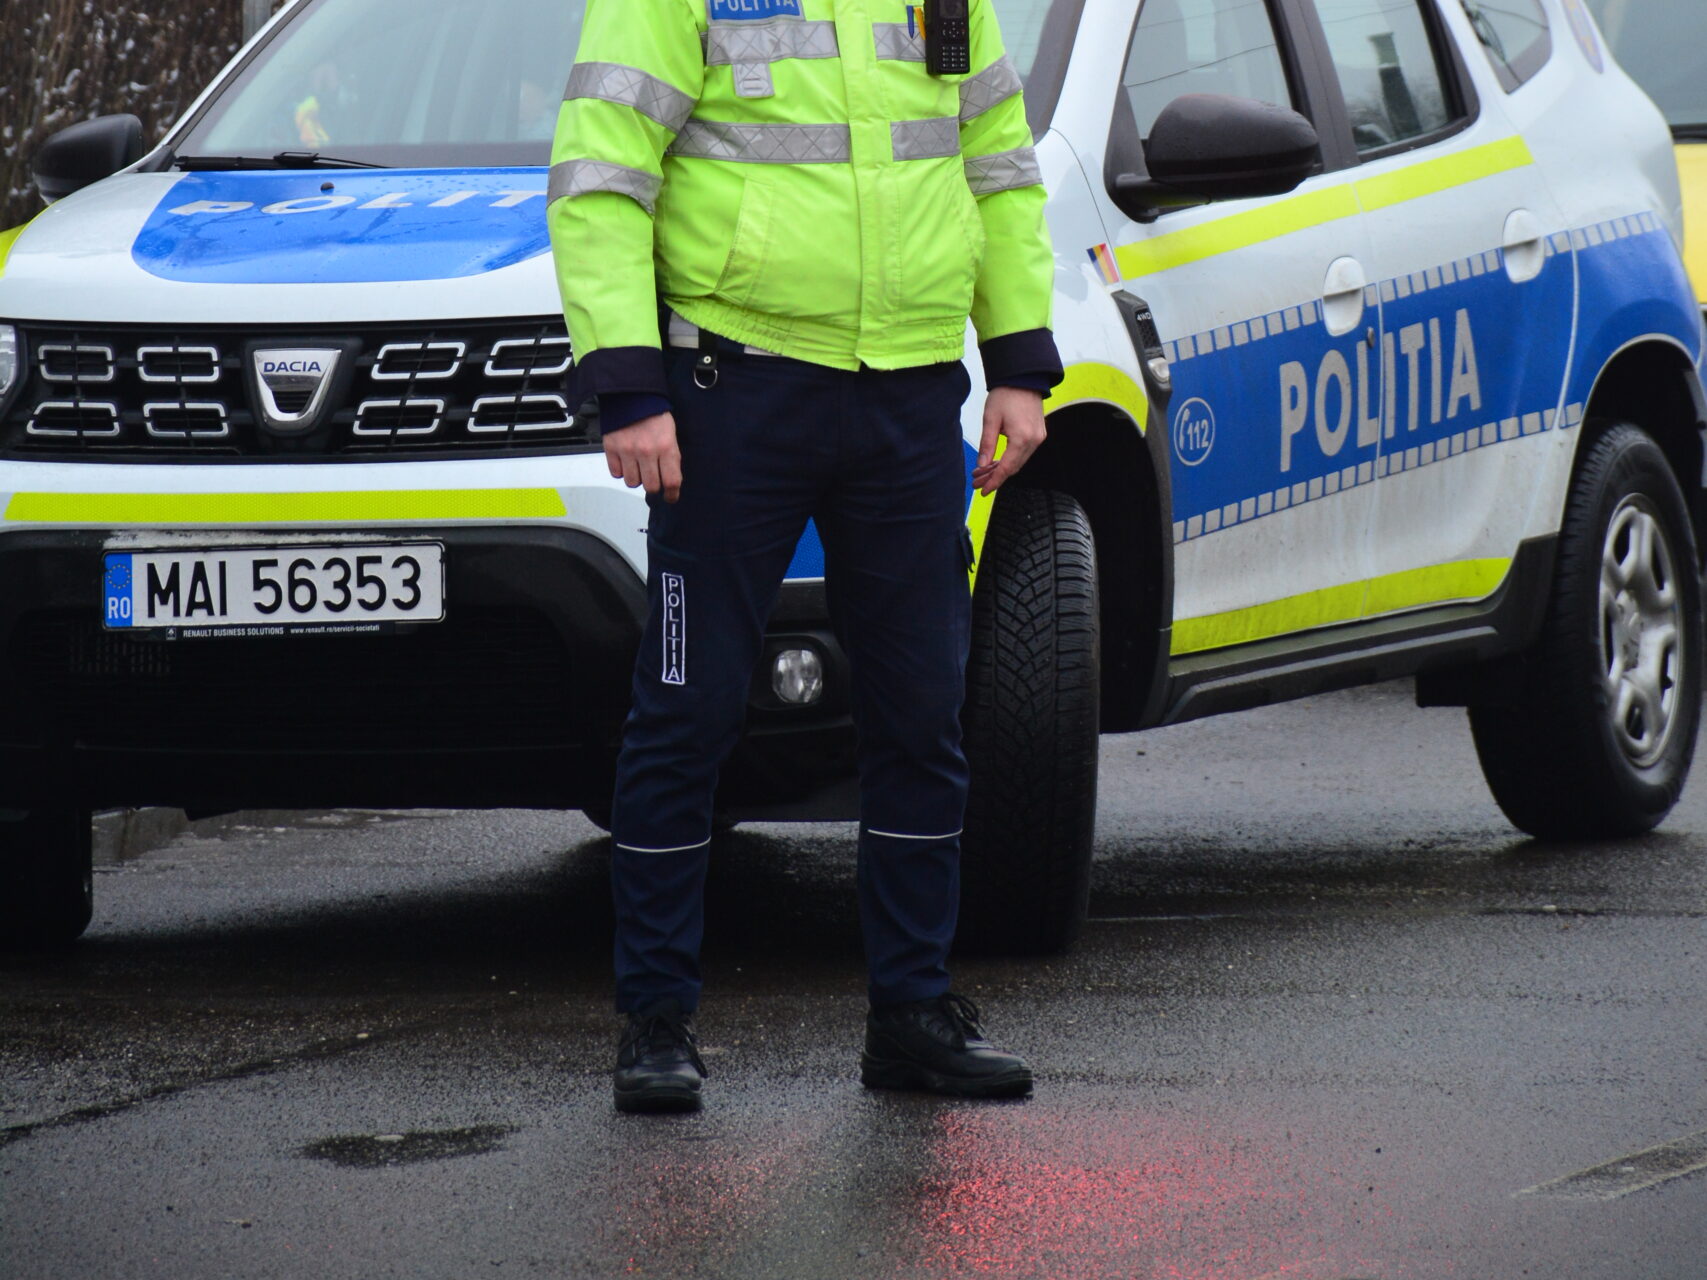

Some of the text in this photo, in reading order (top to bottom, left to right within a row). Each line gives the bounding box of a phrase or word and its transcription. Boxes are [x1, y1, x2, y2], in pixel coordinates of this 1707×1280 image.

[167, 190, 547, 217] POLIT
[263, 361, 321, 373] DACIA
[1279, 308, 1482, 473] POLITIA
[1187, 419, 1209, 451] 112
[108, 555, 421, 620] RO MAI 56353
[183, 629, 212, 638] RENAULT
[213, 628, 246, 637] BUSINESS
[247, 626, 284, 636] SOLUTIONS
[667, 577, 681, 682] POLITIA
